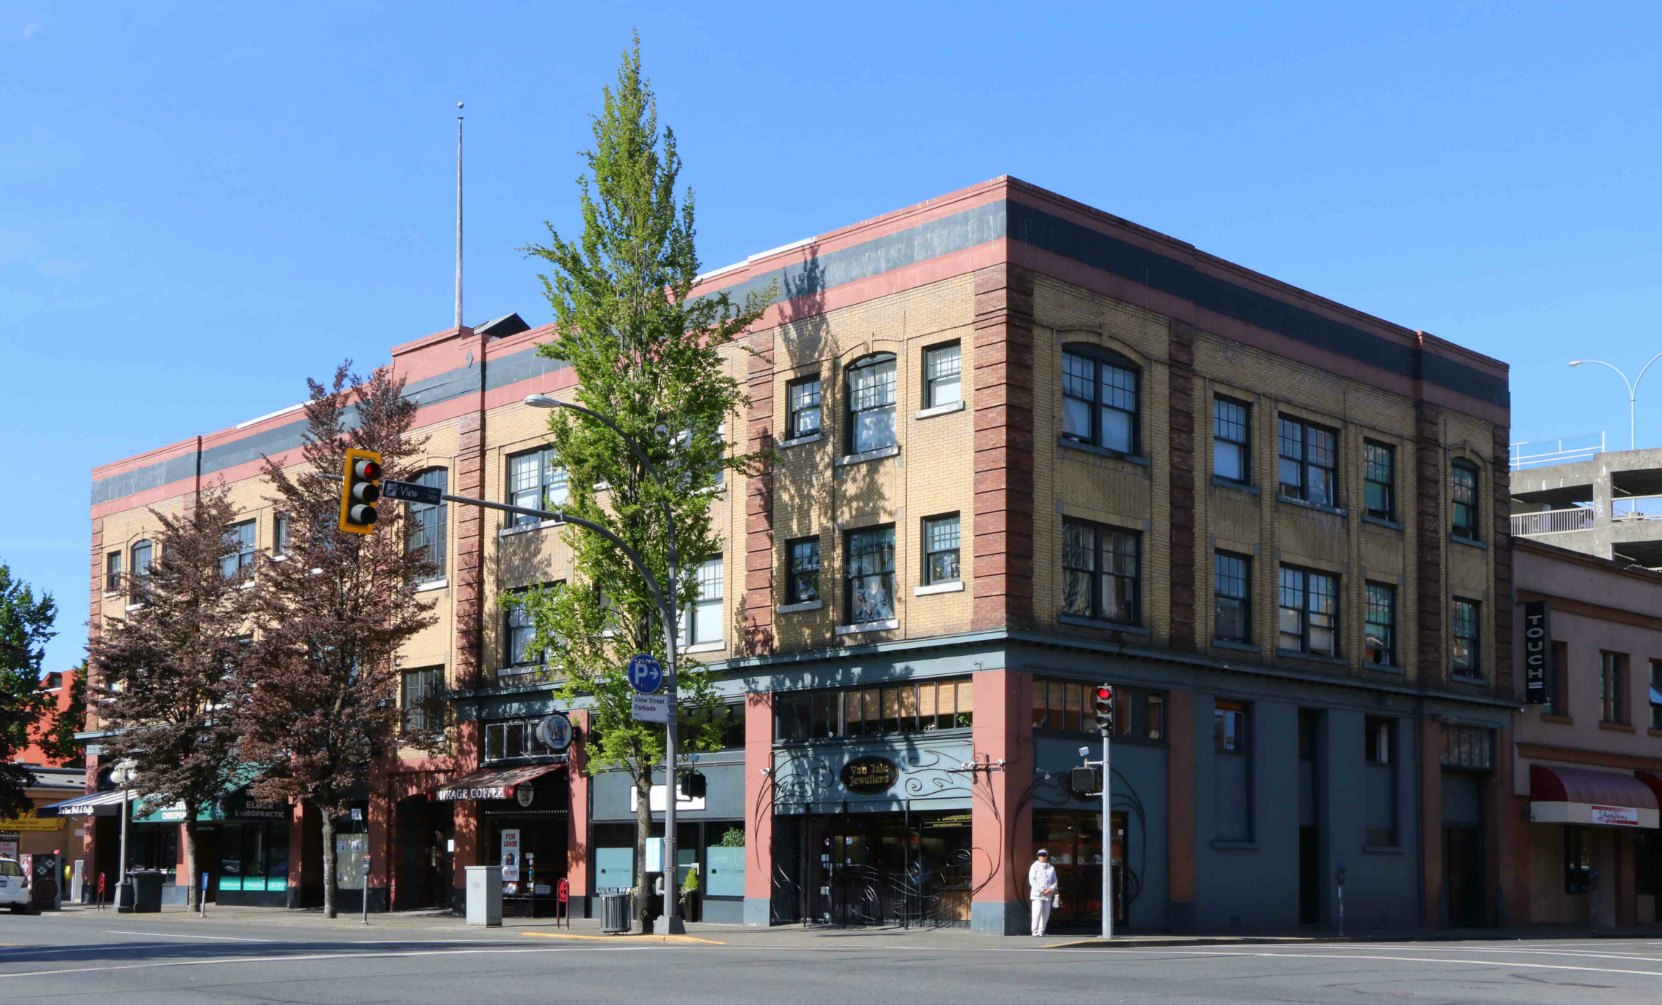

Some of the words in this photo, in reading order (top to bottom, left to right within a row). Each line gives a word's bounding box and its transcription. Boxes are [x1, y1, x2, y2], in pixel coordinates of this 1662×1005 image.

[400, 486, 419, 498] View
[850, 765, 867, 775] Van
[470, 786, 505, 799] COFFEE
